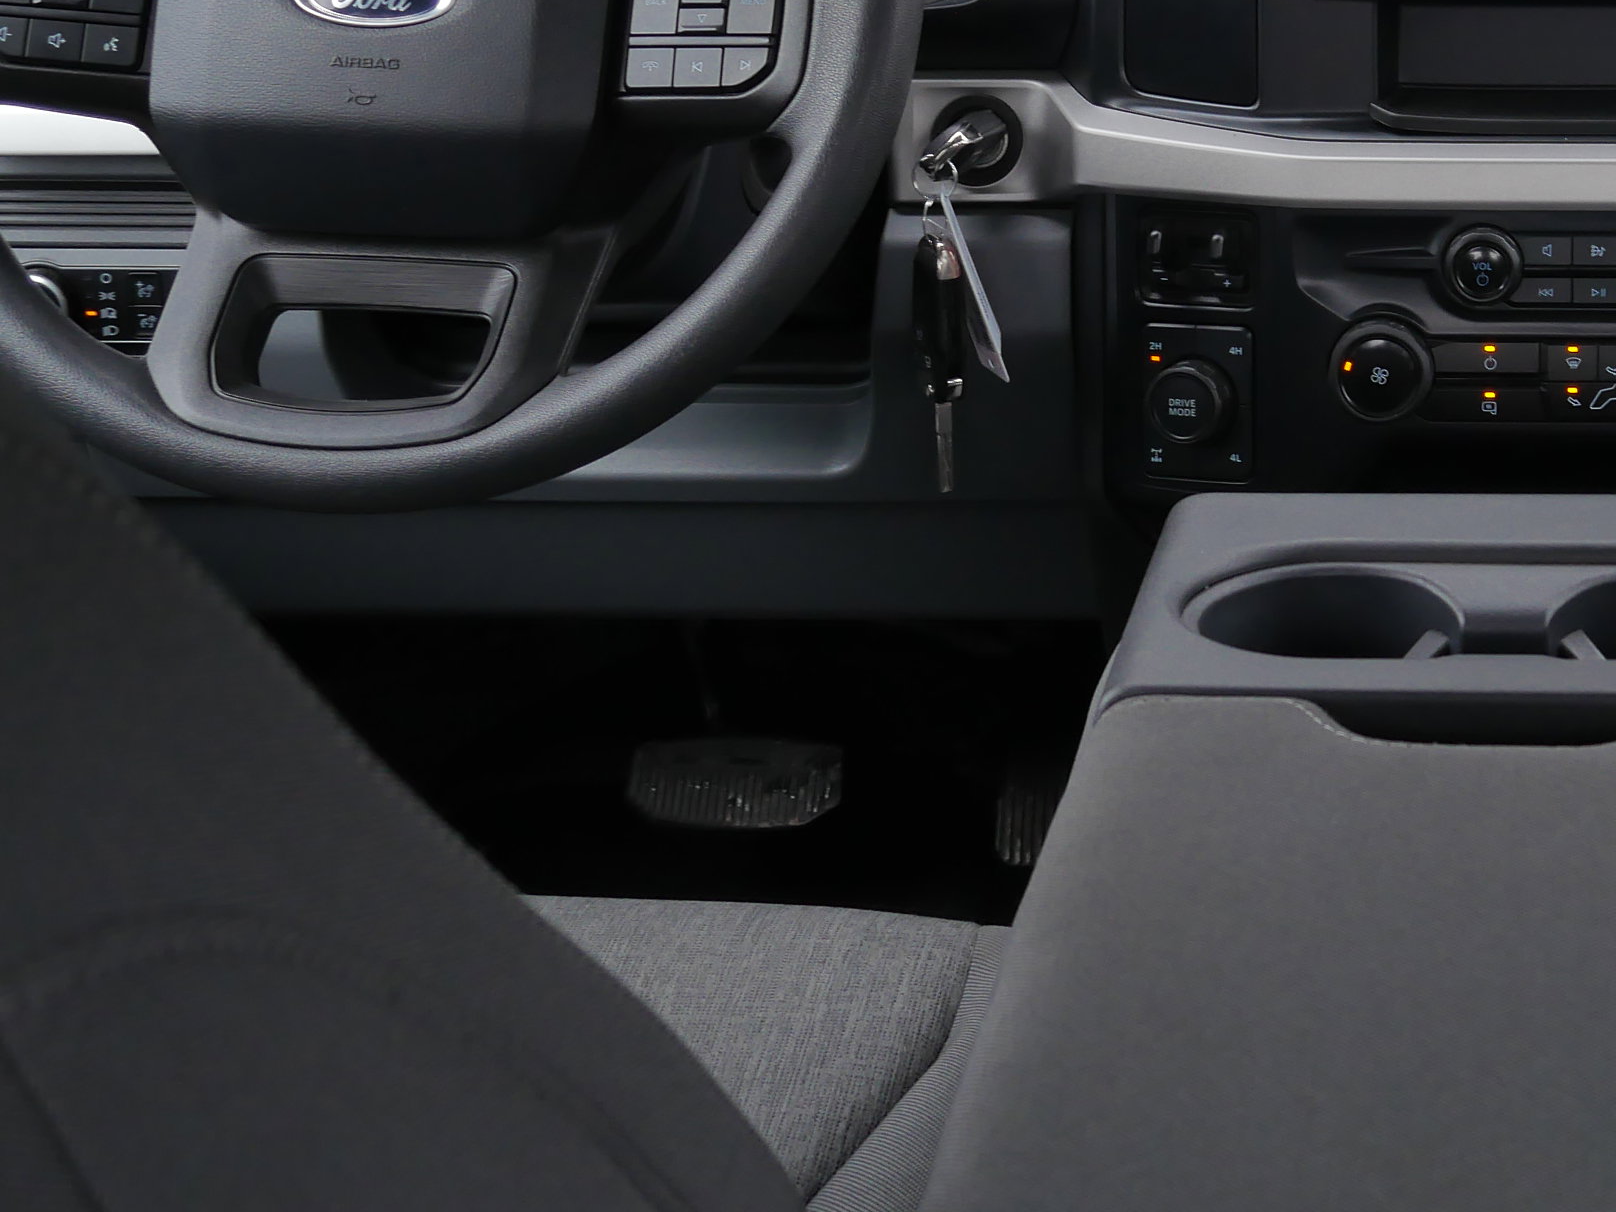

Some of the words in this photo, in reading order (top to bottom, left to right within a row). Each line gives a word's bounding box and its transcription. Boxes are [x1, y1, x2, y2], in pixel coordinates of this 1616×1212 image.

[329, 55, 401, 70] AIRBAG
[1471, 261, 1492, 271] VOL
[1149, 342, 1163, 351] 2H
[1228, 346, 1243, 356] 4H
[1168, 398, 1197, 408] DRIVE
[1168, 408, 1197, 417] MODE
[1229, 453, 1243, 463] 4L
